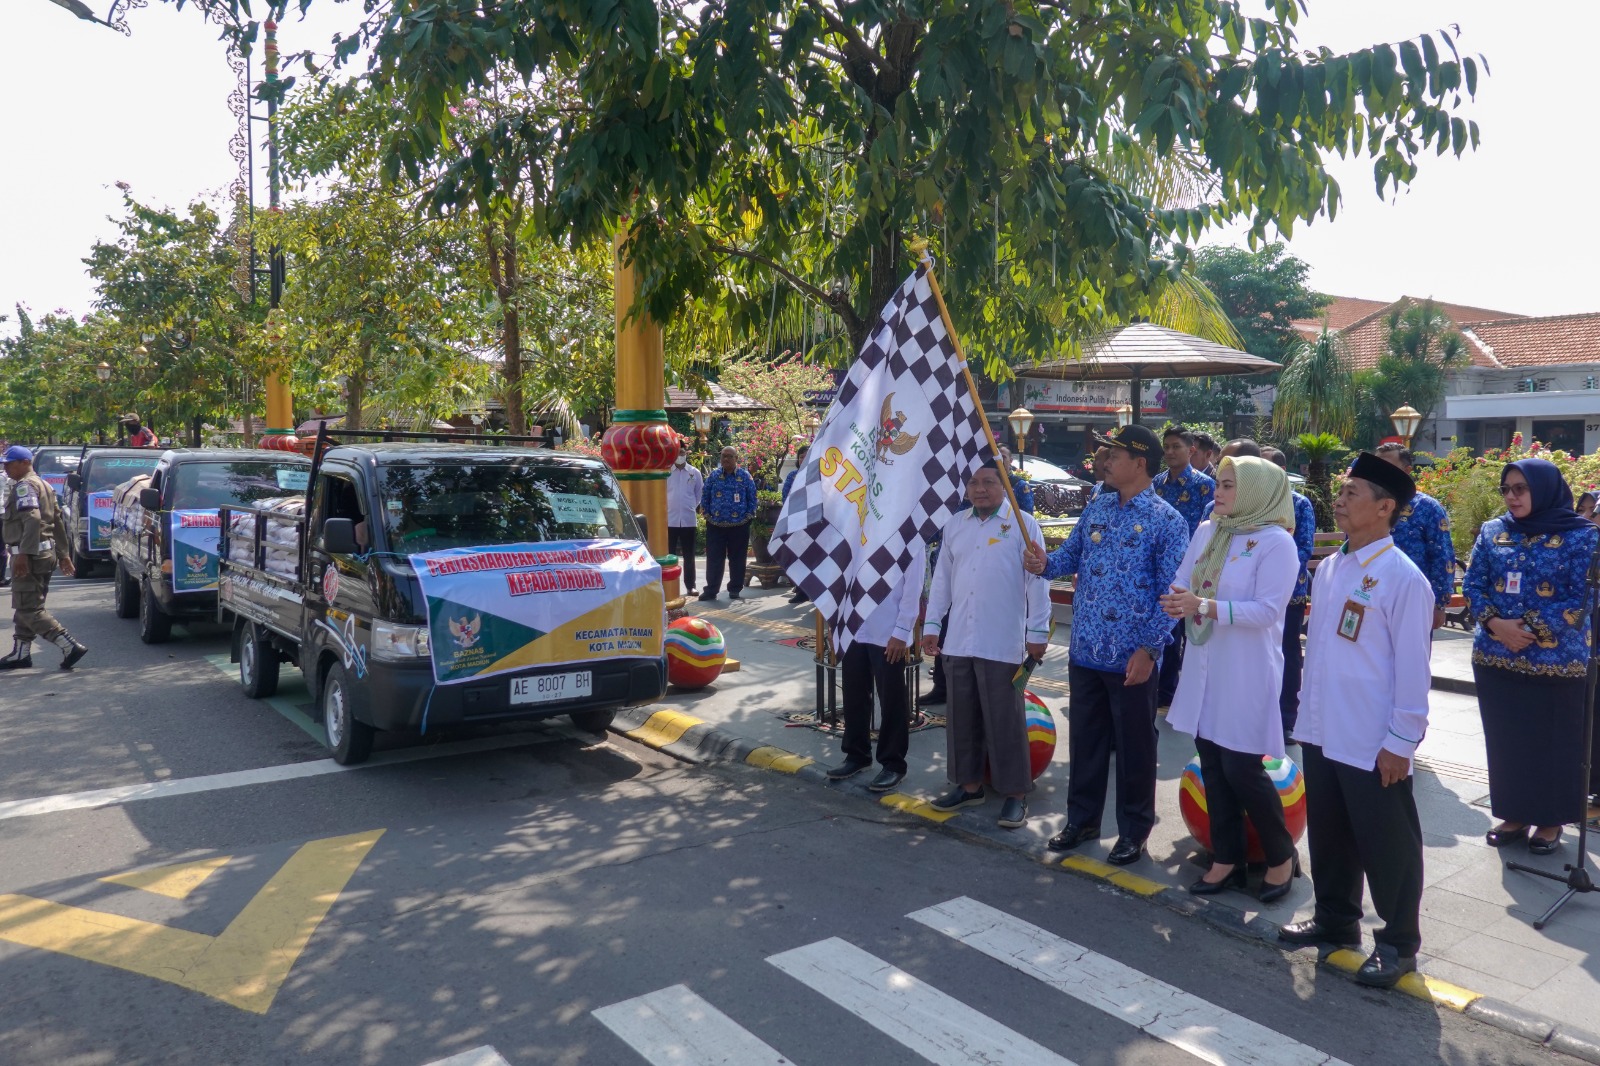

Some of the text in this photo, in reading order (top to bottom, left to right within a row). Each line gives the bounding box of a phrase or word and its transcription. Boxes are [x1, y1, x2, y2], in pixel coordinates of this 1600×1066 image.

[1056, 393, 1088, 403] Indonesia
[1089, 395, 1106, 404] Pulih
[1586, 424, 1600, 432] 37
[849, 421, 869, 447] Badan
[505, 568, 606, 597] KEPADA DHUAFA
[629, 628, 653, 637] TAMAN
[589, 641, 614, 652] KOTA
[453, 647, 484, 658] BAZNAS
[514, 673, 590, 696] AE 8007 BH
